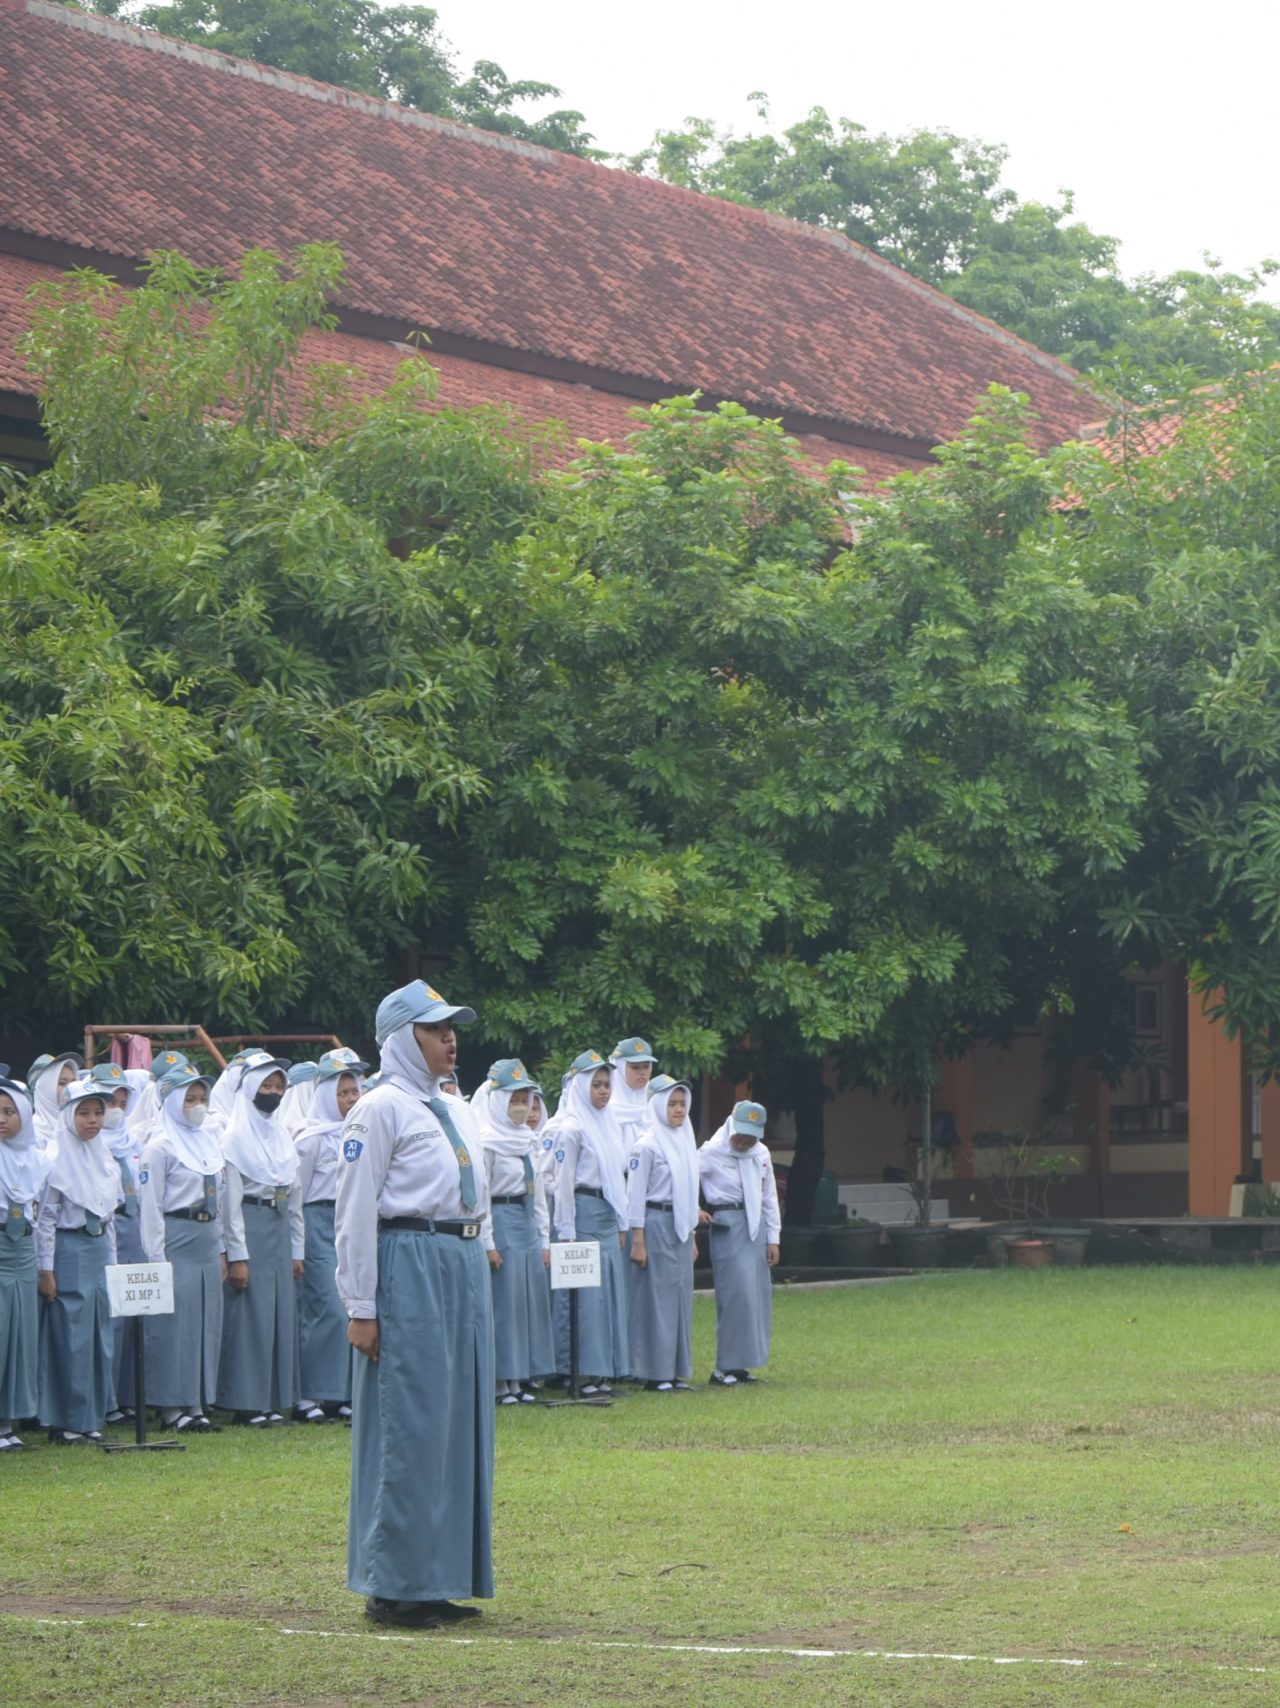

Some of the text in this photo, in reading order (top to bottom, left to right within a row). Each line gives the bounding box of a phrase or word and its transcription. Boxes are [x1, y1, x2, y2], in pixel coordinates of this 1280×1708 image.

[348, 1141, 357, 1150] XI
[564, 1249, 590, 1260] KELAS
[560, 1264, 569, 1275] XI
[126, 1272, 160, 1284] KELAS
[125, 1288, 162, 1301] XI MP 1
